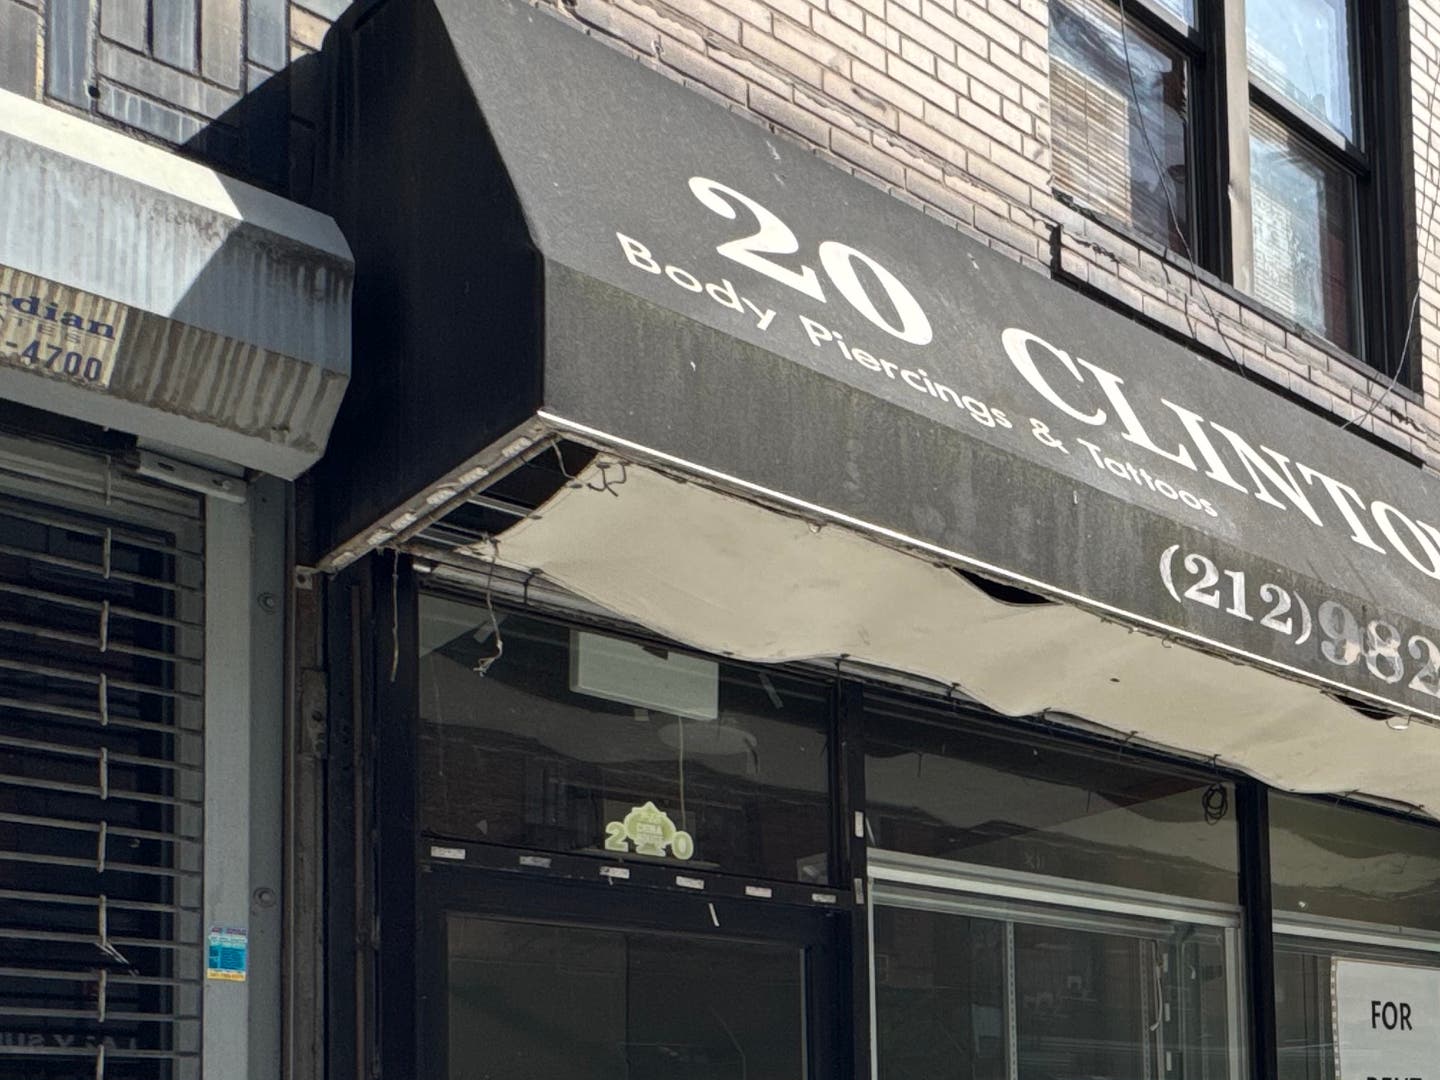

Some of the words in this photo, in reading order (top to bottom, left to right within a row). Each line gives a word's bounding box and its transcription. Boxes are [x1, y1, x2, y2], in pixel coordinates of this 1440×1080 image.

[688, 176, 933, 346] 20
[616, 232, 777, 331] Body
[799, 314, 1013, 430] Piercings
[1031, 416, 1070, 455] &
[1077, 437, 1219, 517] Tattoos
[1370, 1000, 1413, 1031] FOR
